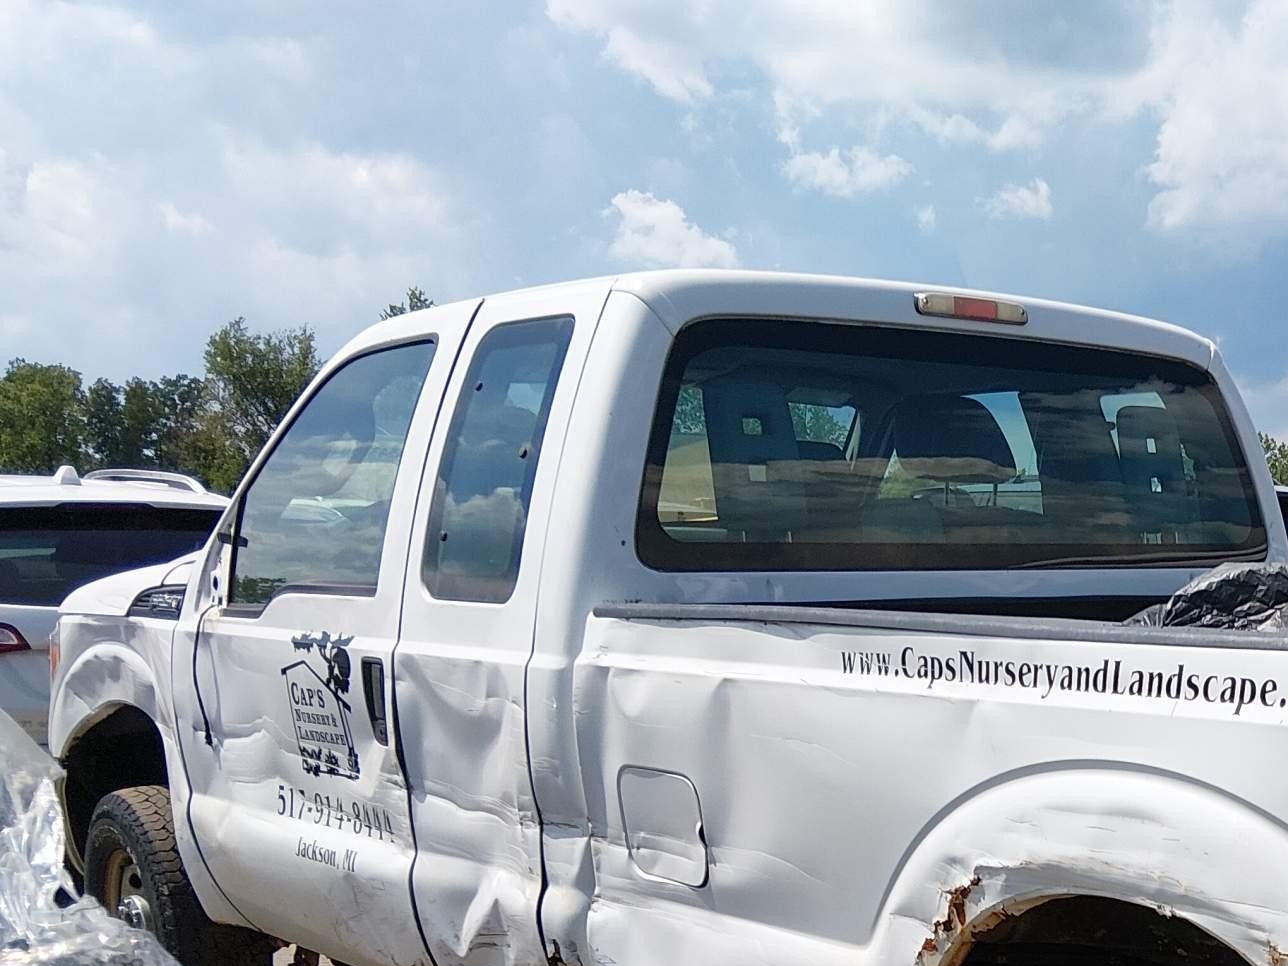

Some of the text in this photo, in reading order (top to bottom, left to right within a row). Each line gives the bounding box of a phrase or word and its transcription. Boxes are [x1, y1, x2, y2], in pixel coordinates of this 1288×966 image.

[290, 682, 325, 708] CAP'S
[297, 725, 347, 746] LANDSCAPE
[277, 784, 395, 844] 517-914-8444
[295, 836, 340, 871] Jackson,
